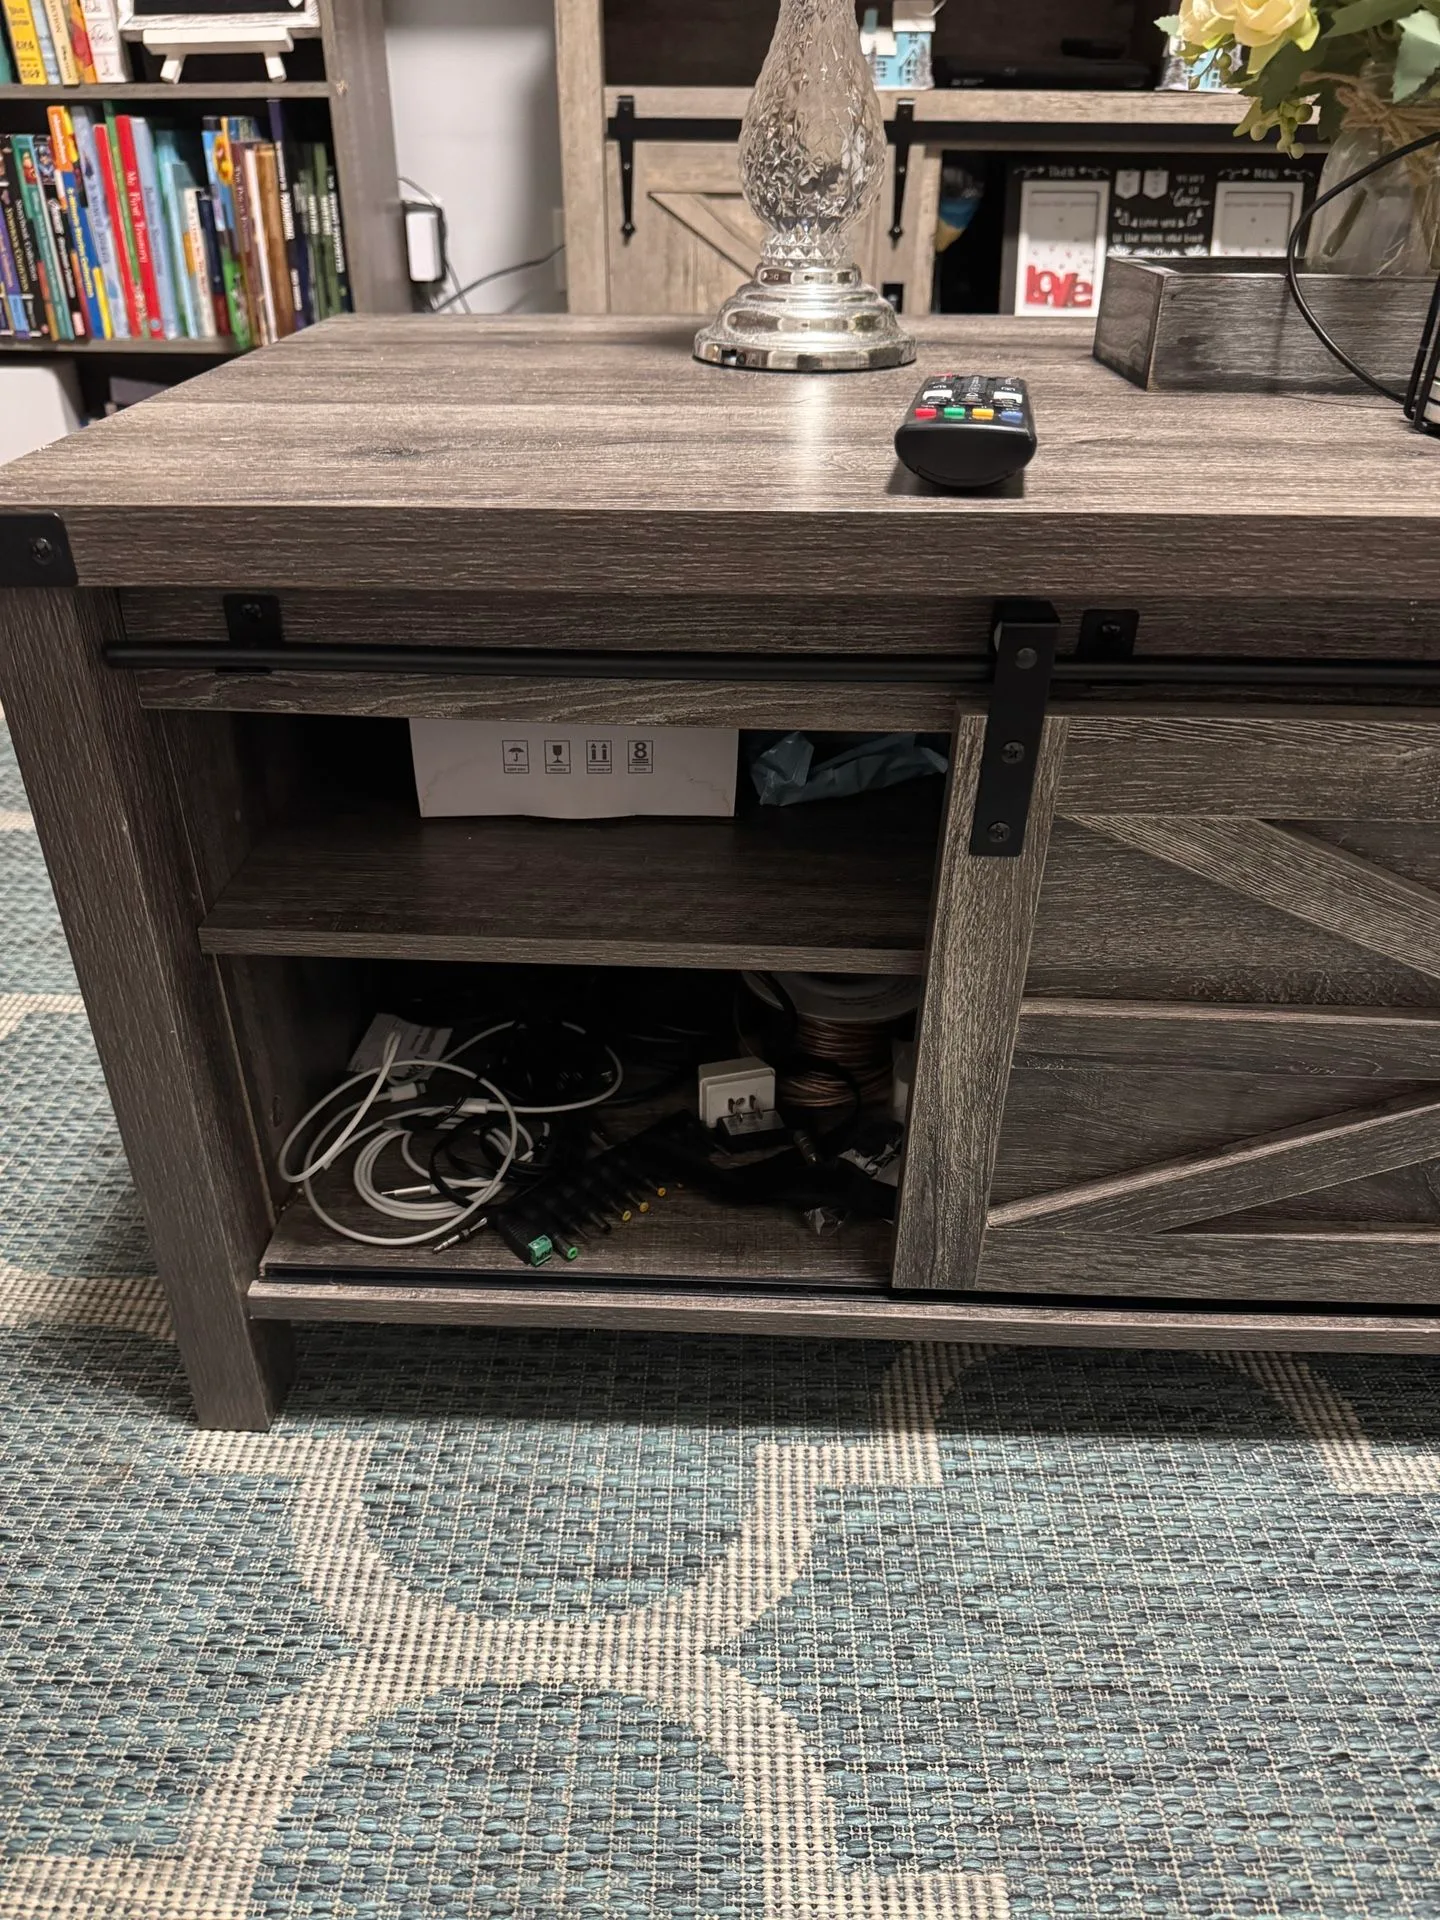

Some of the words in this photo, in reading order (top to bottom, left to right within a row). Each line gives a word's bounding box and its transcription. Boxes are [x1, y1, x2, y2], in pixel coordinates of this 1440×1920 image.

[129, 191, 143, 218] First
[1026, 265, 1094, 308] love
[633, 742, 647, 759] 8
